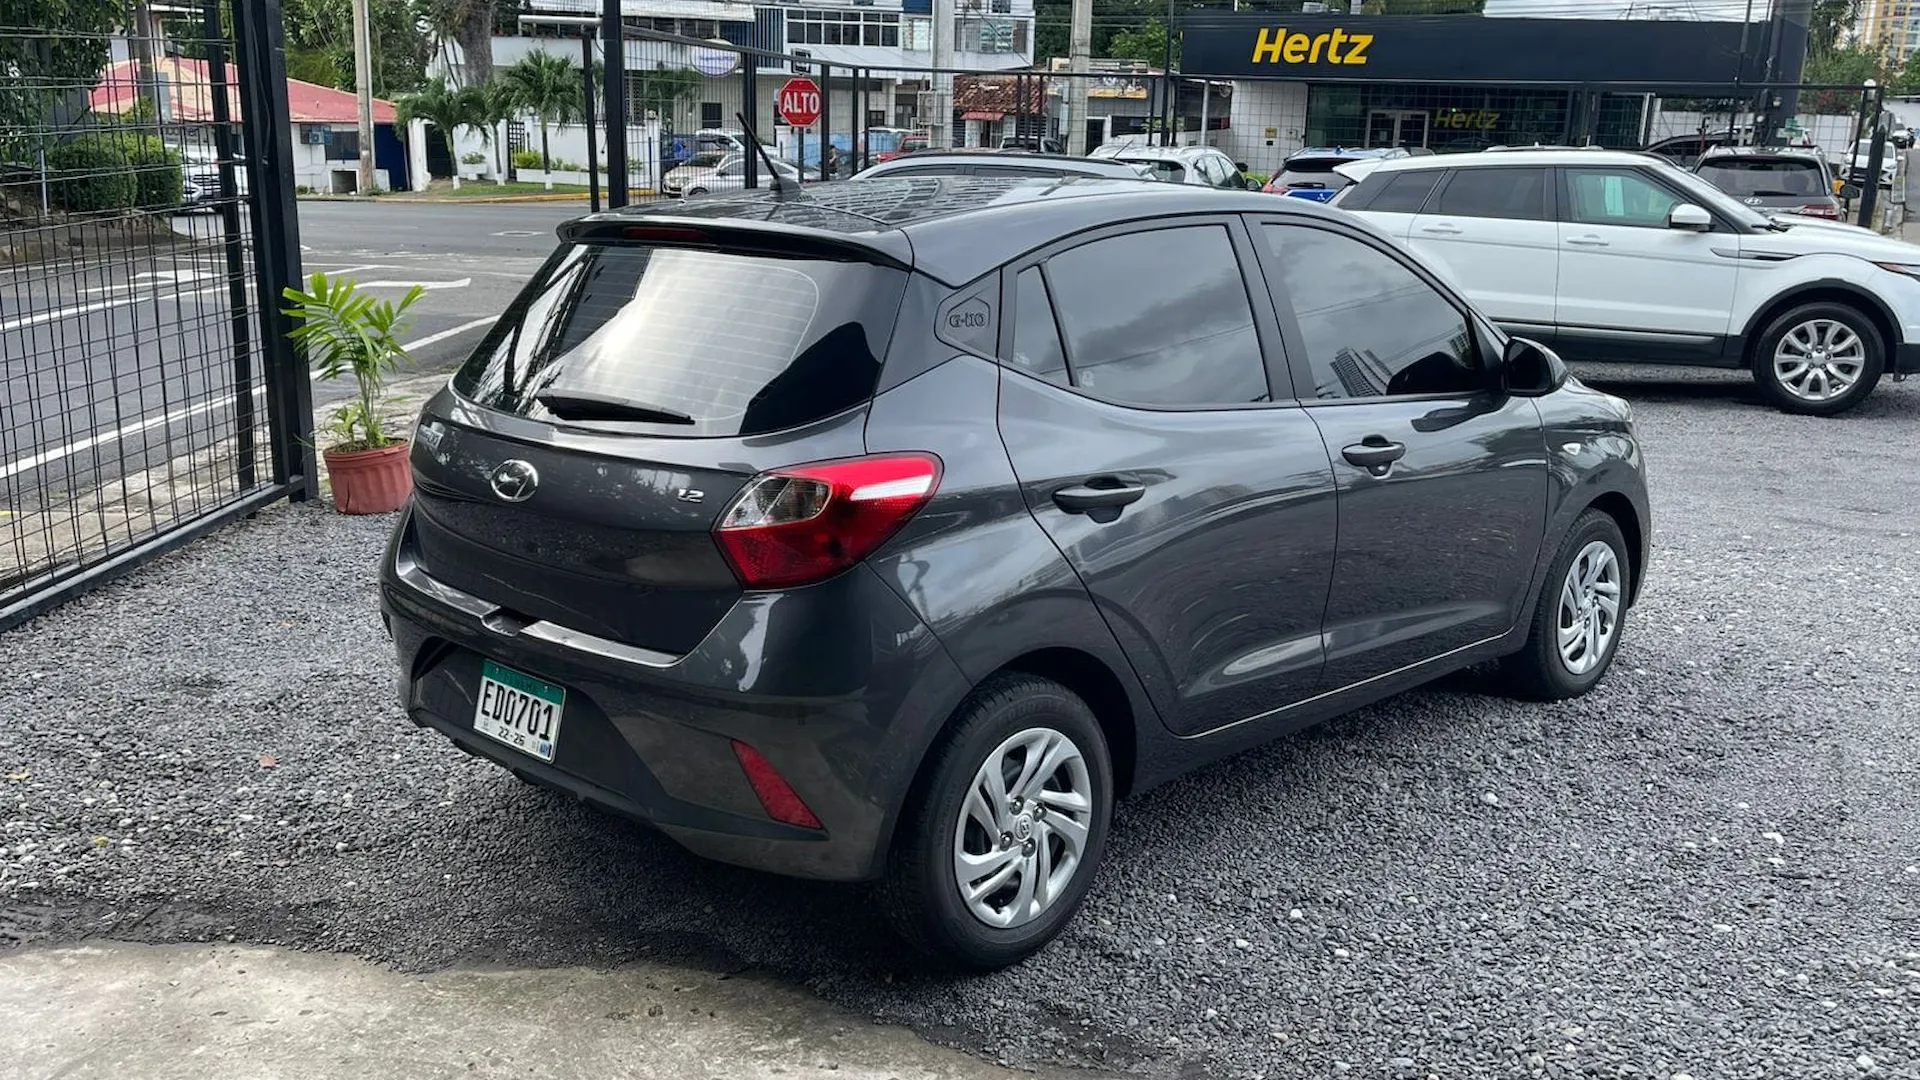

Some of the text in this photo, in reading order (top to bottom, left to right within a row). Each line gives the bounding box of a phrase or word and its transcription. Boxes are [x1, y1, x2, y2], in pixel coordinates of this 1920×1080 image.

[1252, 28, 1373, 64] Hertz
[783, 91, 820, 114] ALTO
[1433, 109, 1500, 129] Hertz
[481, 680, 554, 741] ED0701
